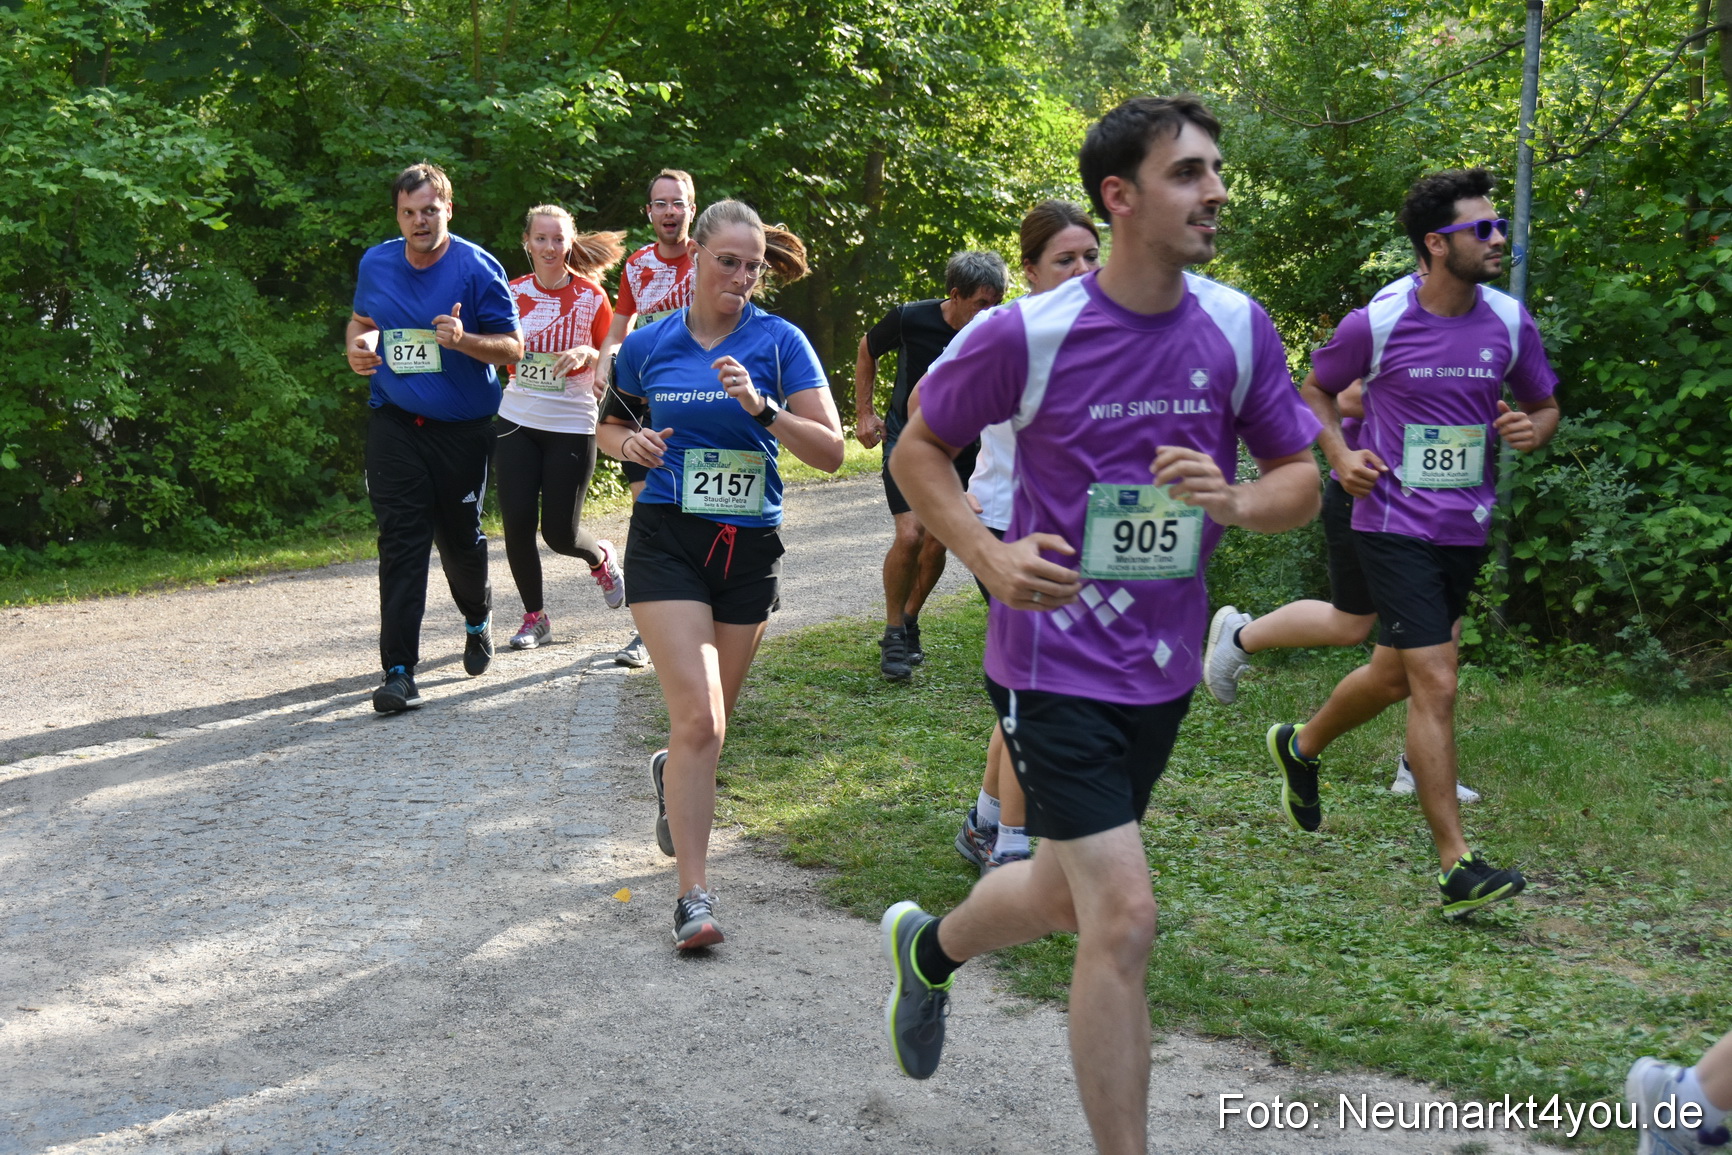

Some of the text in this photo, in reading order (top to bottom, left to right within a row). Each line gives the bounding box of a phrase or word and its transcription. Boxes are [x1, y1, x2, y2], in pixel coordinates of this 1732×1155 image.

[394, 345, 427, 360] 874
[1408, 367, 1496, 378] WIR SIND LILA.
[1088, 399, 1211, 419] WIR SIND LILA.
[1423, 448, 1466, 470] 881
[694, 472, 755, 496] 2157
[704, 496, 731, 504] Staudigl
[1113, 520, 1178, 553] 905
